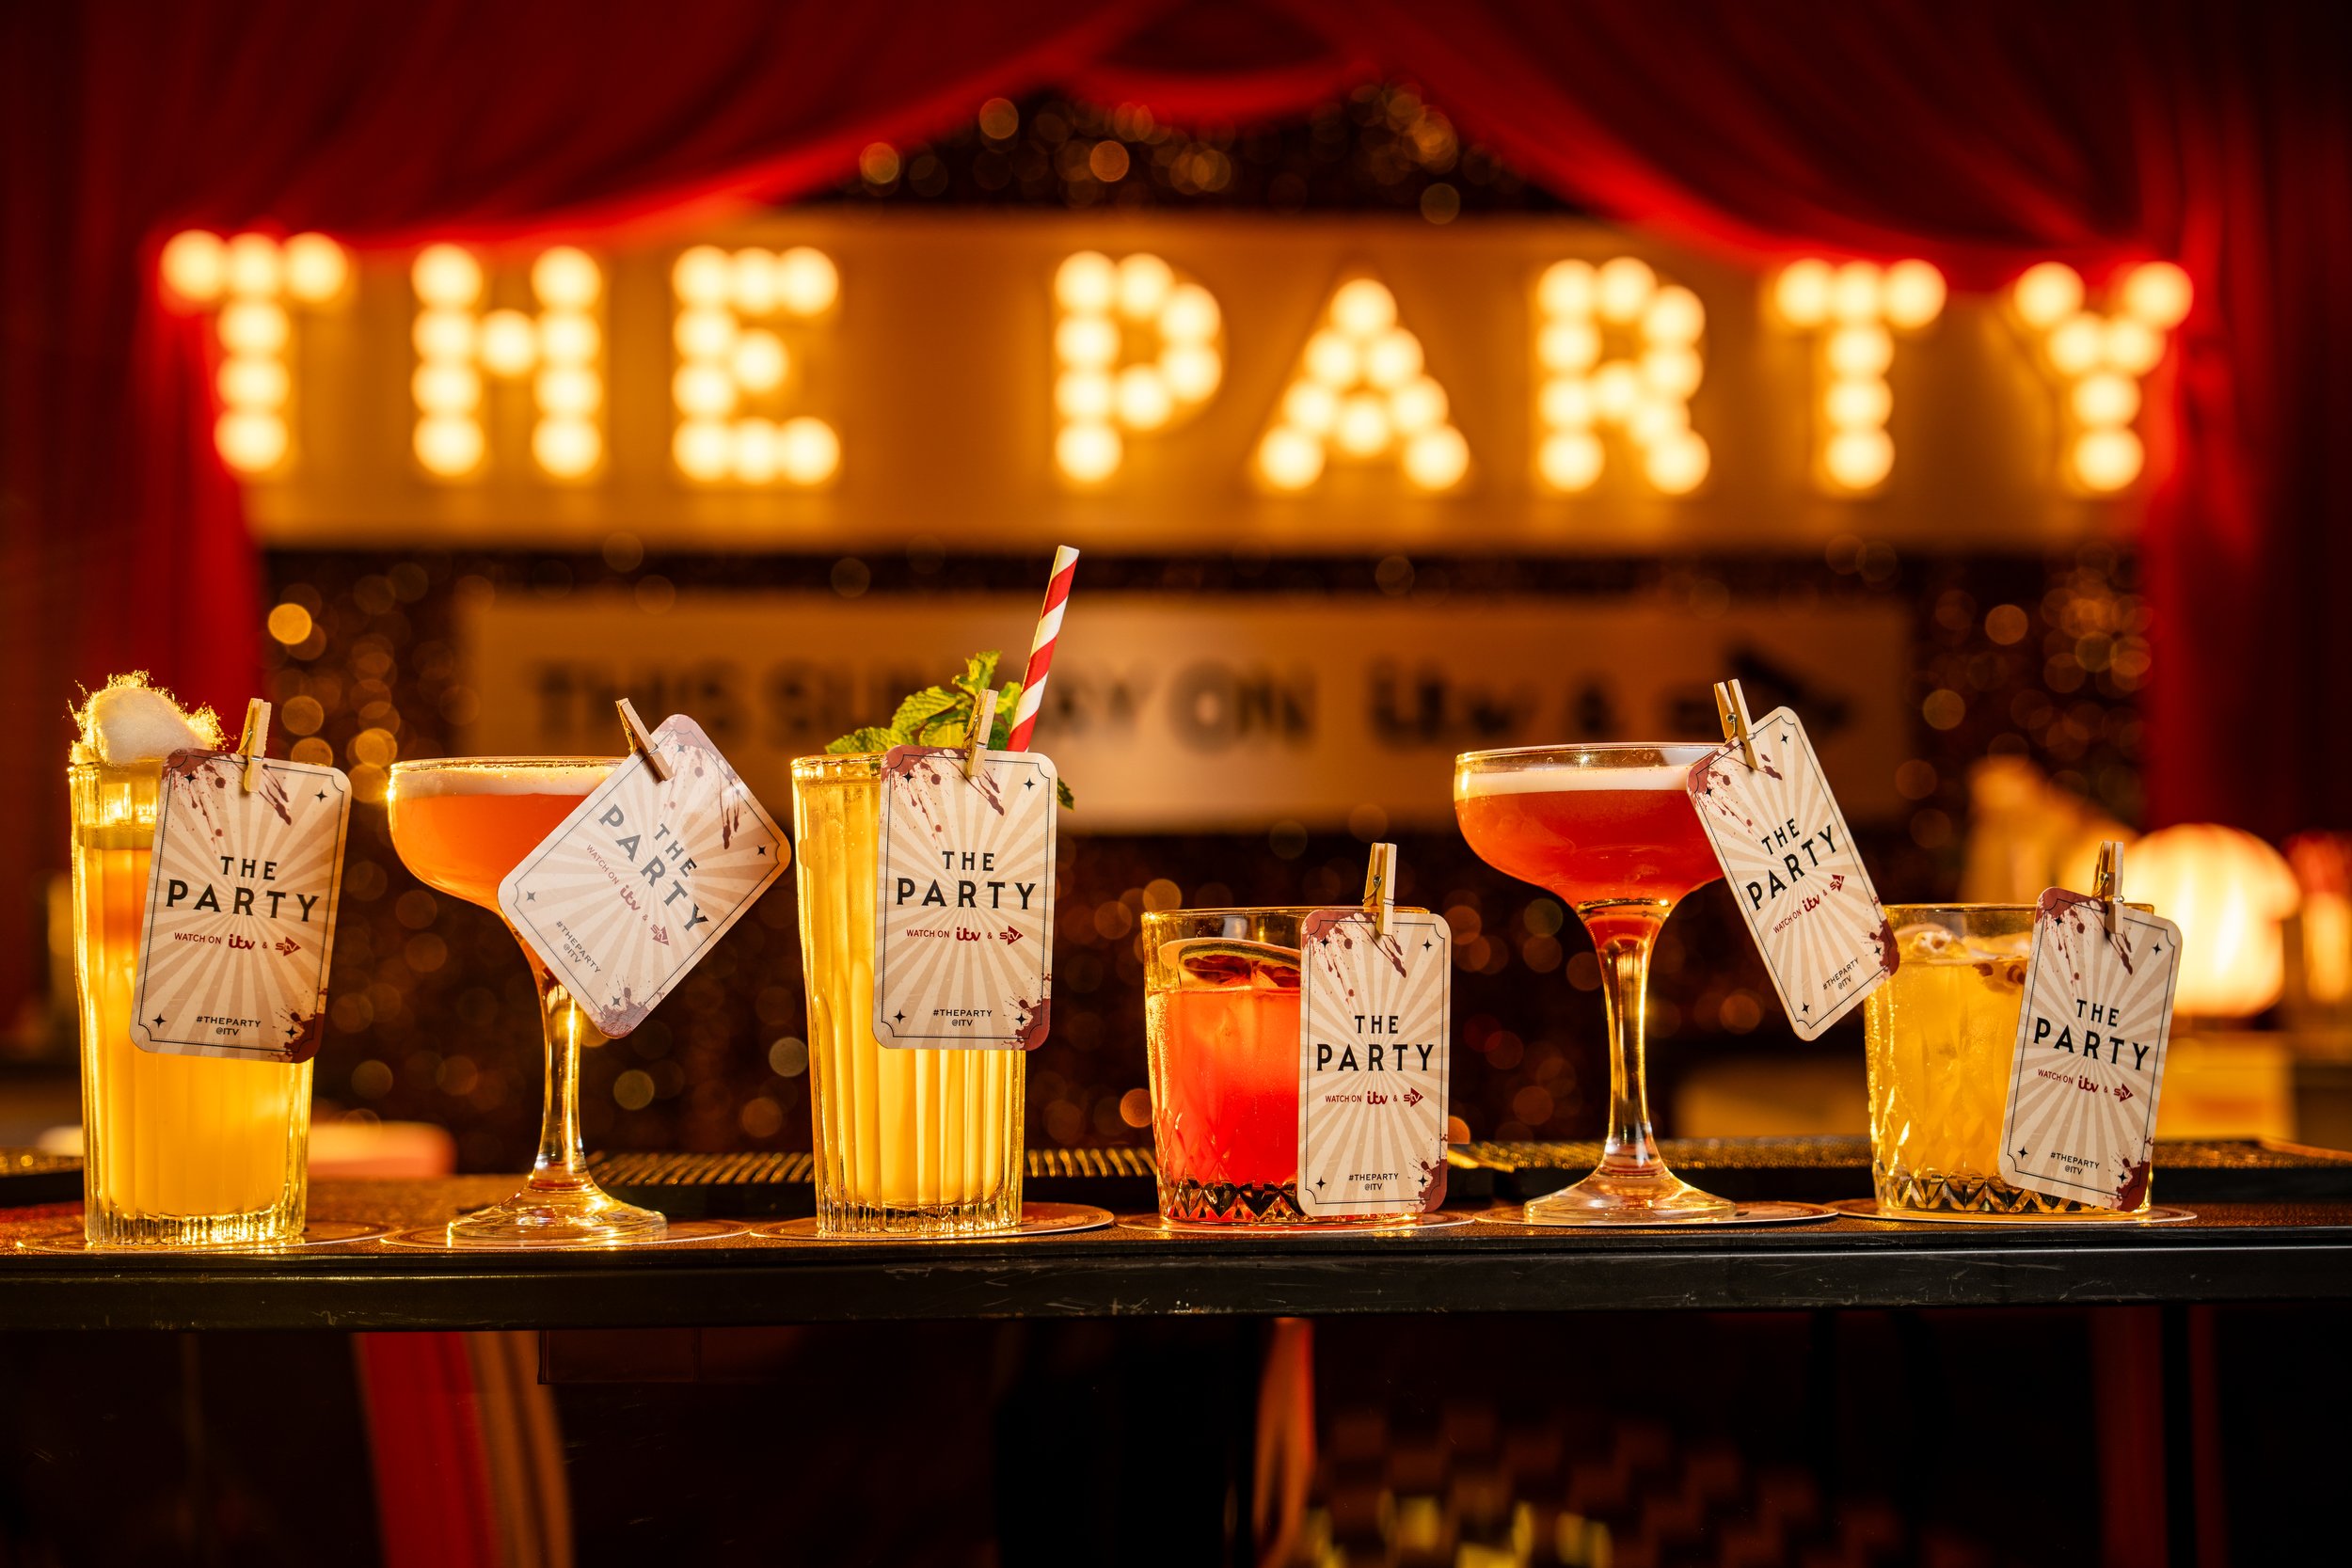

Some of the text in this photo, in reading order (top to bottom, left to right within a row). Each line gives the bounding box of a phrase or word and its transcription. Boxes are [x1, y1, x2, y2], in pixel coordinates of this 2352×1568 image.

[160, 229, 2195, 497] THE PARTY
[1761, 817, 1801, 856] THE
[653, 823, 697, 878] THE
[942, 850, 994, 872] THE
[220, 856, 278, 880] THE
[597, 803, 708, 932] PARTY
[1746, 824, 1837, 911] PARTY
[587, 844, 610, 873] WATCH
[607, 871, 619, 885] ON
[619, 884, 642, 911] itv
[642, 913, 648, 922] &
[896, 878, 1036, 911] PARTY
[166, 879, 320, 923] PARTY
[1772, 915, 1793, 935] WATCH
[1791, 909, 1803, 924] ON
[1802, 894, 1820, 913] itv
[174, 932, 206, 943] WATCH
[207, 934, 222, 944] ON
[228, 933, 256, 950] itv
[906, 928, 936, 938] WATCH
[937, 929, 950, 938] ON
[956, 927, 981, 942] itv
[555, 921, 601, 974] #THEPARTY
[1821, 957, 1860, 990] #THEPARTY
[196, 1015, 262, 1028] #THEPARTY
[932, 1009, 993, 1018] #THEPARTY
[951, 1019, 973, 1027] @ITV
[1354, 1015, 1399, 1035] THE
[2076, 998, 2120, 1027] THE
[215, 1026, 239, 1037] @ITV
[2033, 1017, 2151, 1071] PARTY
[1316, 1043, 1435, 1071] PARTY
[2038, 1069, 2061, 1083] WATCH
[2062, 1075, 2074, 1085] ON
[2077, 1075, 2099, 1094] itv
[2103, 1085, 2108, 1094] &
[1325, 1095, 1350, 1103] WATCH
[1351, 1094, 1361, 1102] ON
[1366, 1090, 1388, 1105] itv
[2050, 1151, 2100, 1170] #THEPARTY
[2064, 1164, 2083, 1176] @ITV
[1348, 1173, 1399, 1181] #THEPARTY
[1364, 1182, 1383, 1191] @ITV
